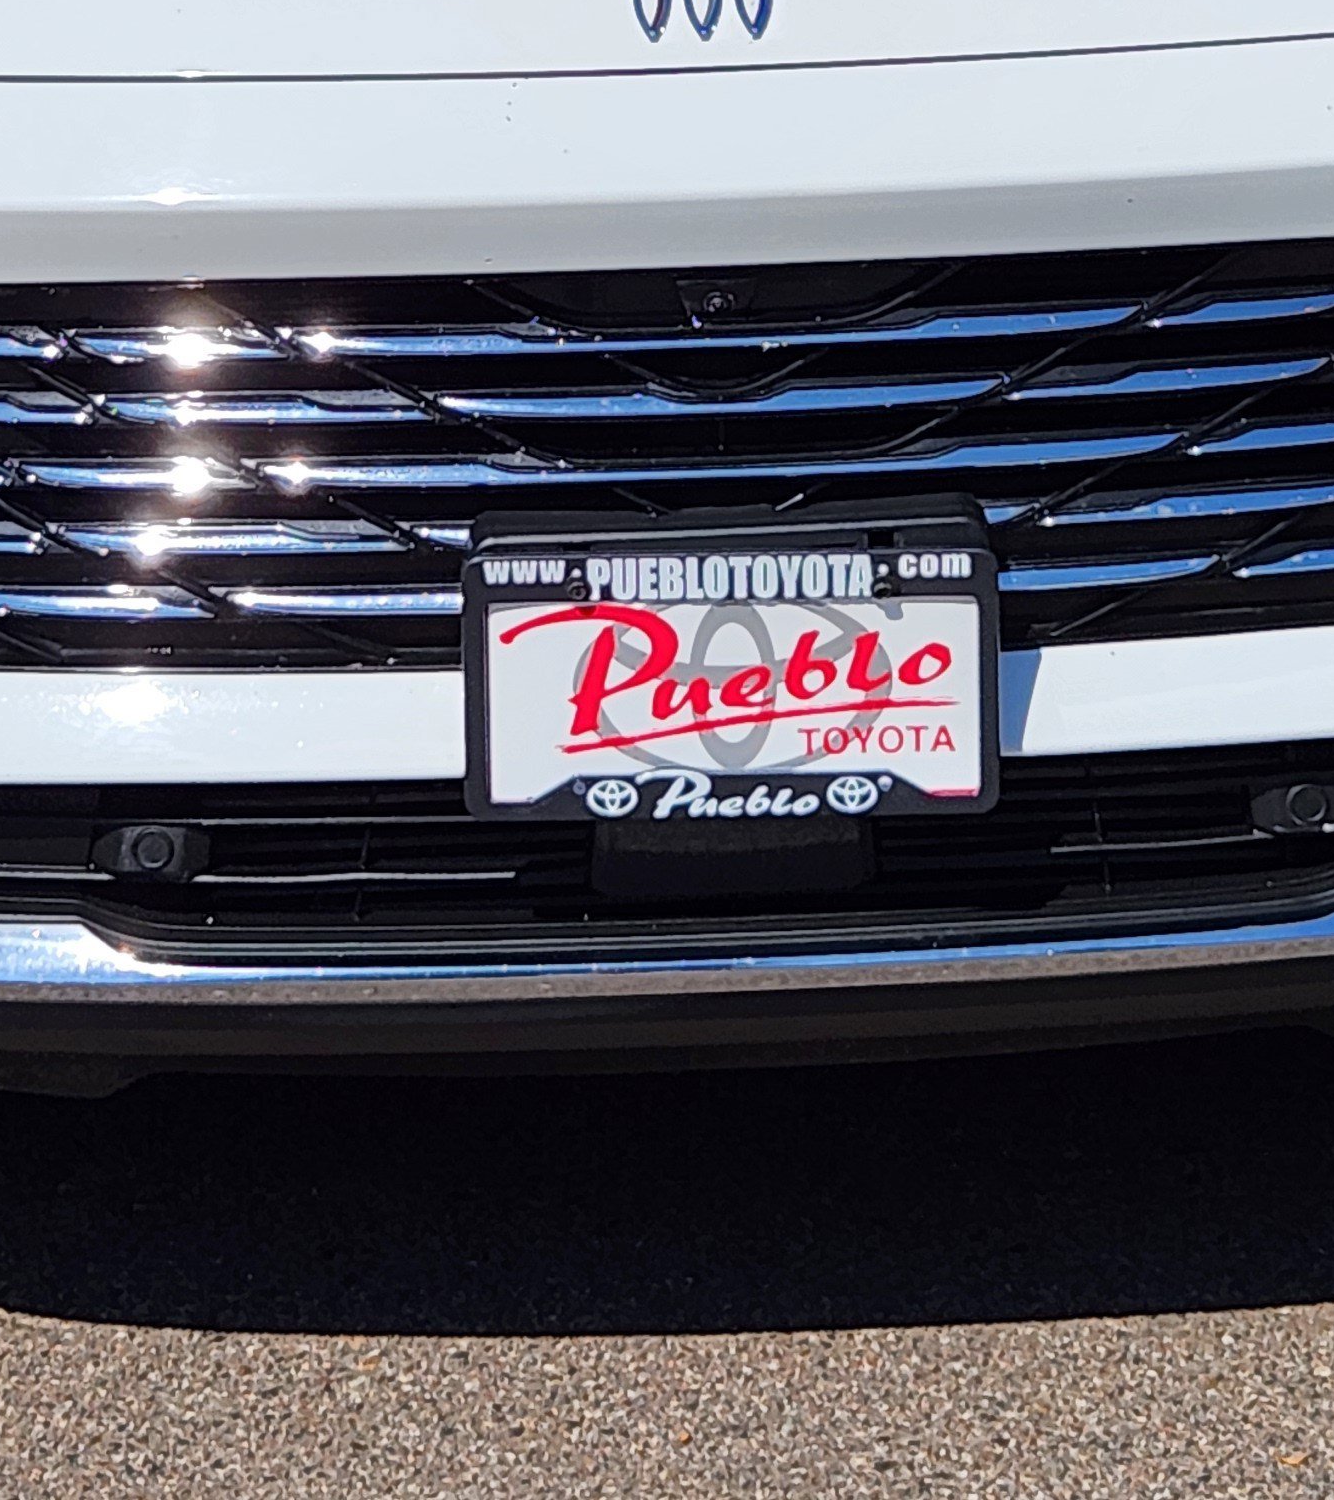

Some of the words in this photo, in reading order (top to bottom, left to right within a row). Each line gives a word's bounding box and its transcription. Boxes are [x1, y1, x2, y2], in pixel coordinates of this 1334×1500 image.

[499, 603, 953, 736] Pueblo
[798, 725, 956, 756] TOYOTA
[635, 766, 821, 819] Pueblo
